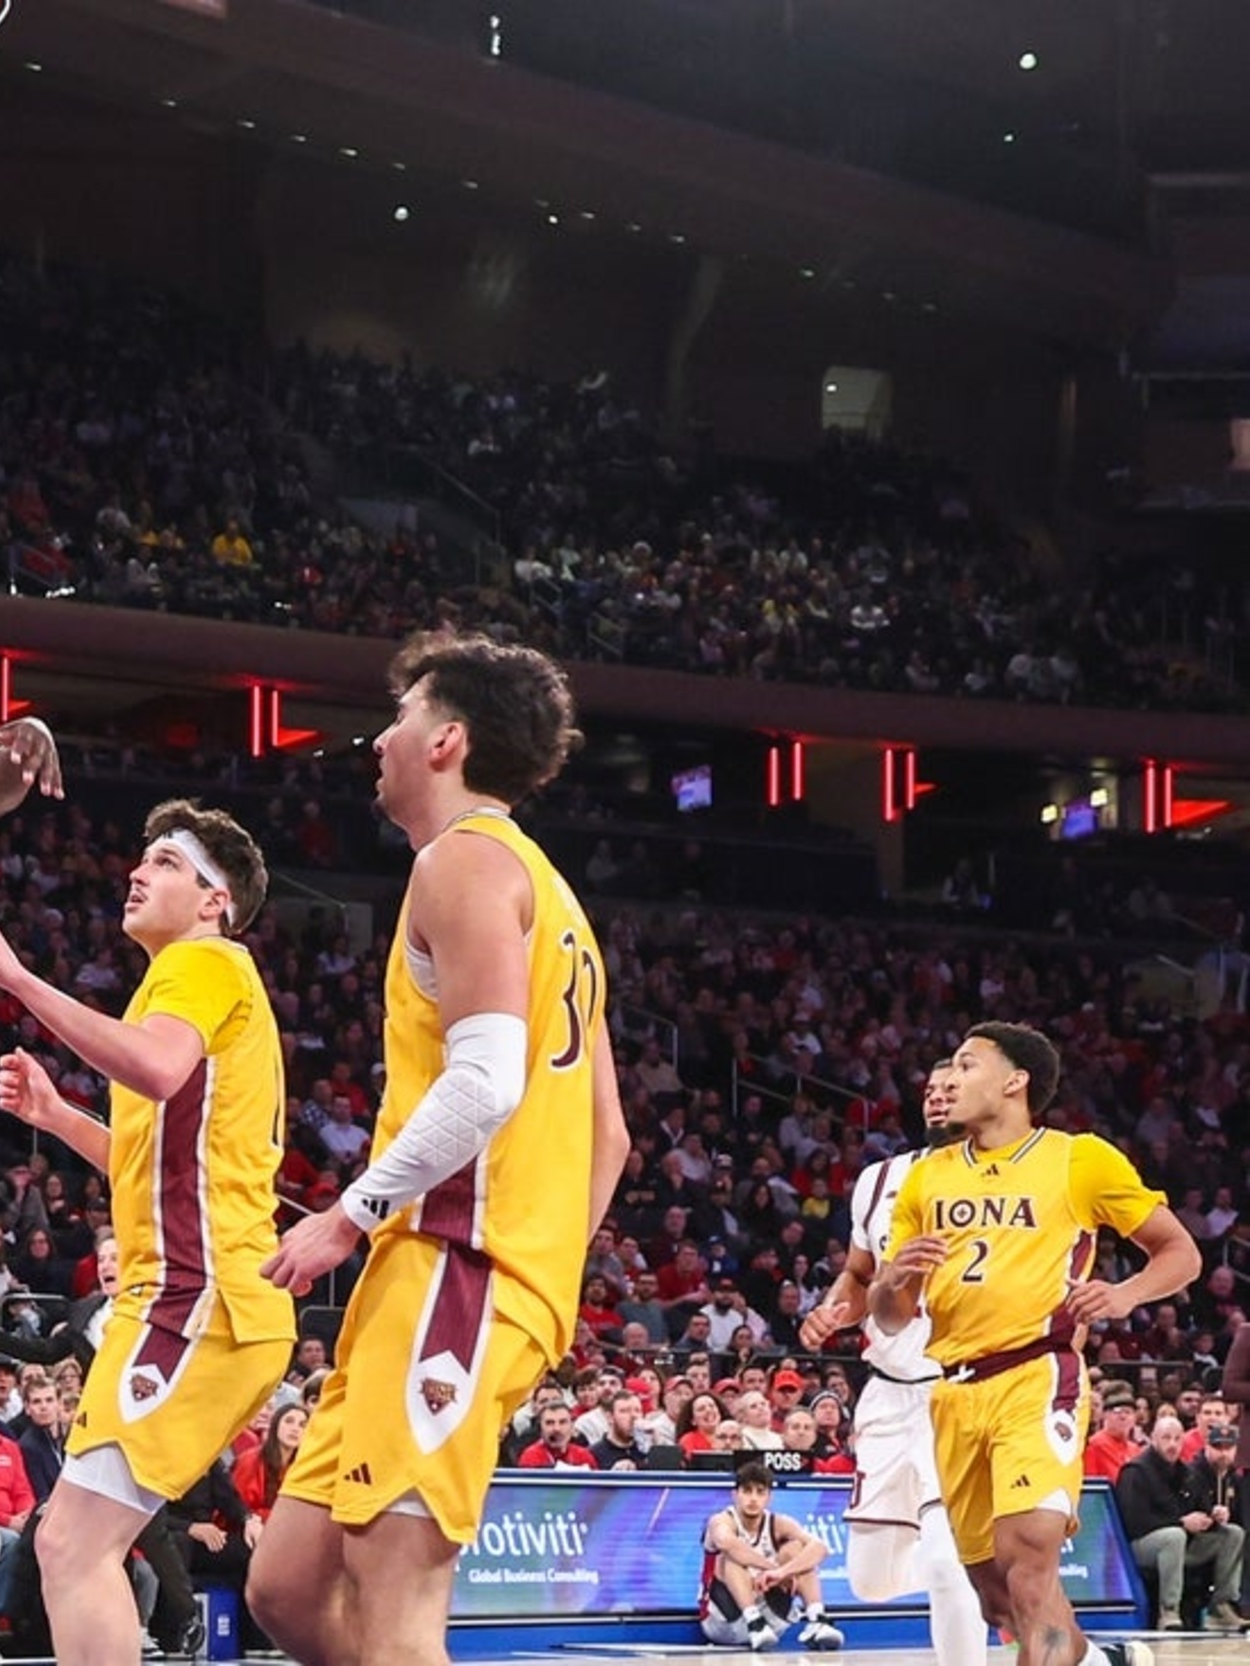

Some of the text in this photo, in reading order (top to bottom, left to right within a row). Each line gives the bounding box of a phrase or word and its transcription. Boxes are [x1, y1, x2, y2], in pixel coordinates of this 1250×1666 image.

[935, 1197, 1037, 1230] IONA
[961, 1240, 989, 1282] 2
[764, 1452, 801, 1471] POSS
[454, 1511, 584, 1572] otiviti
